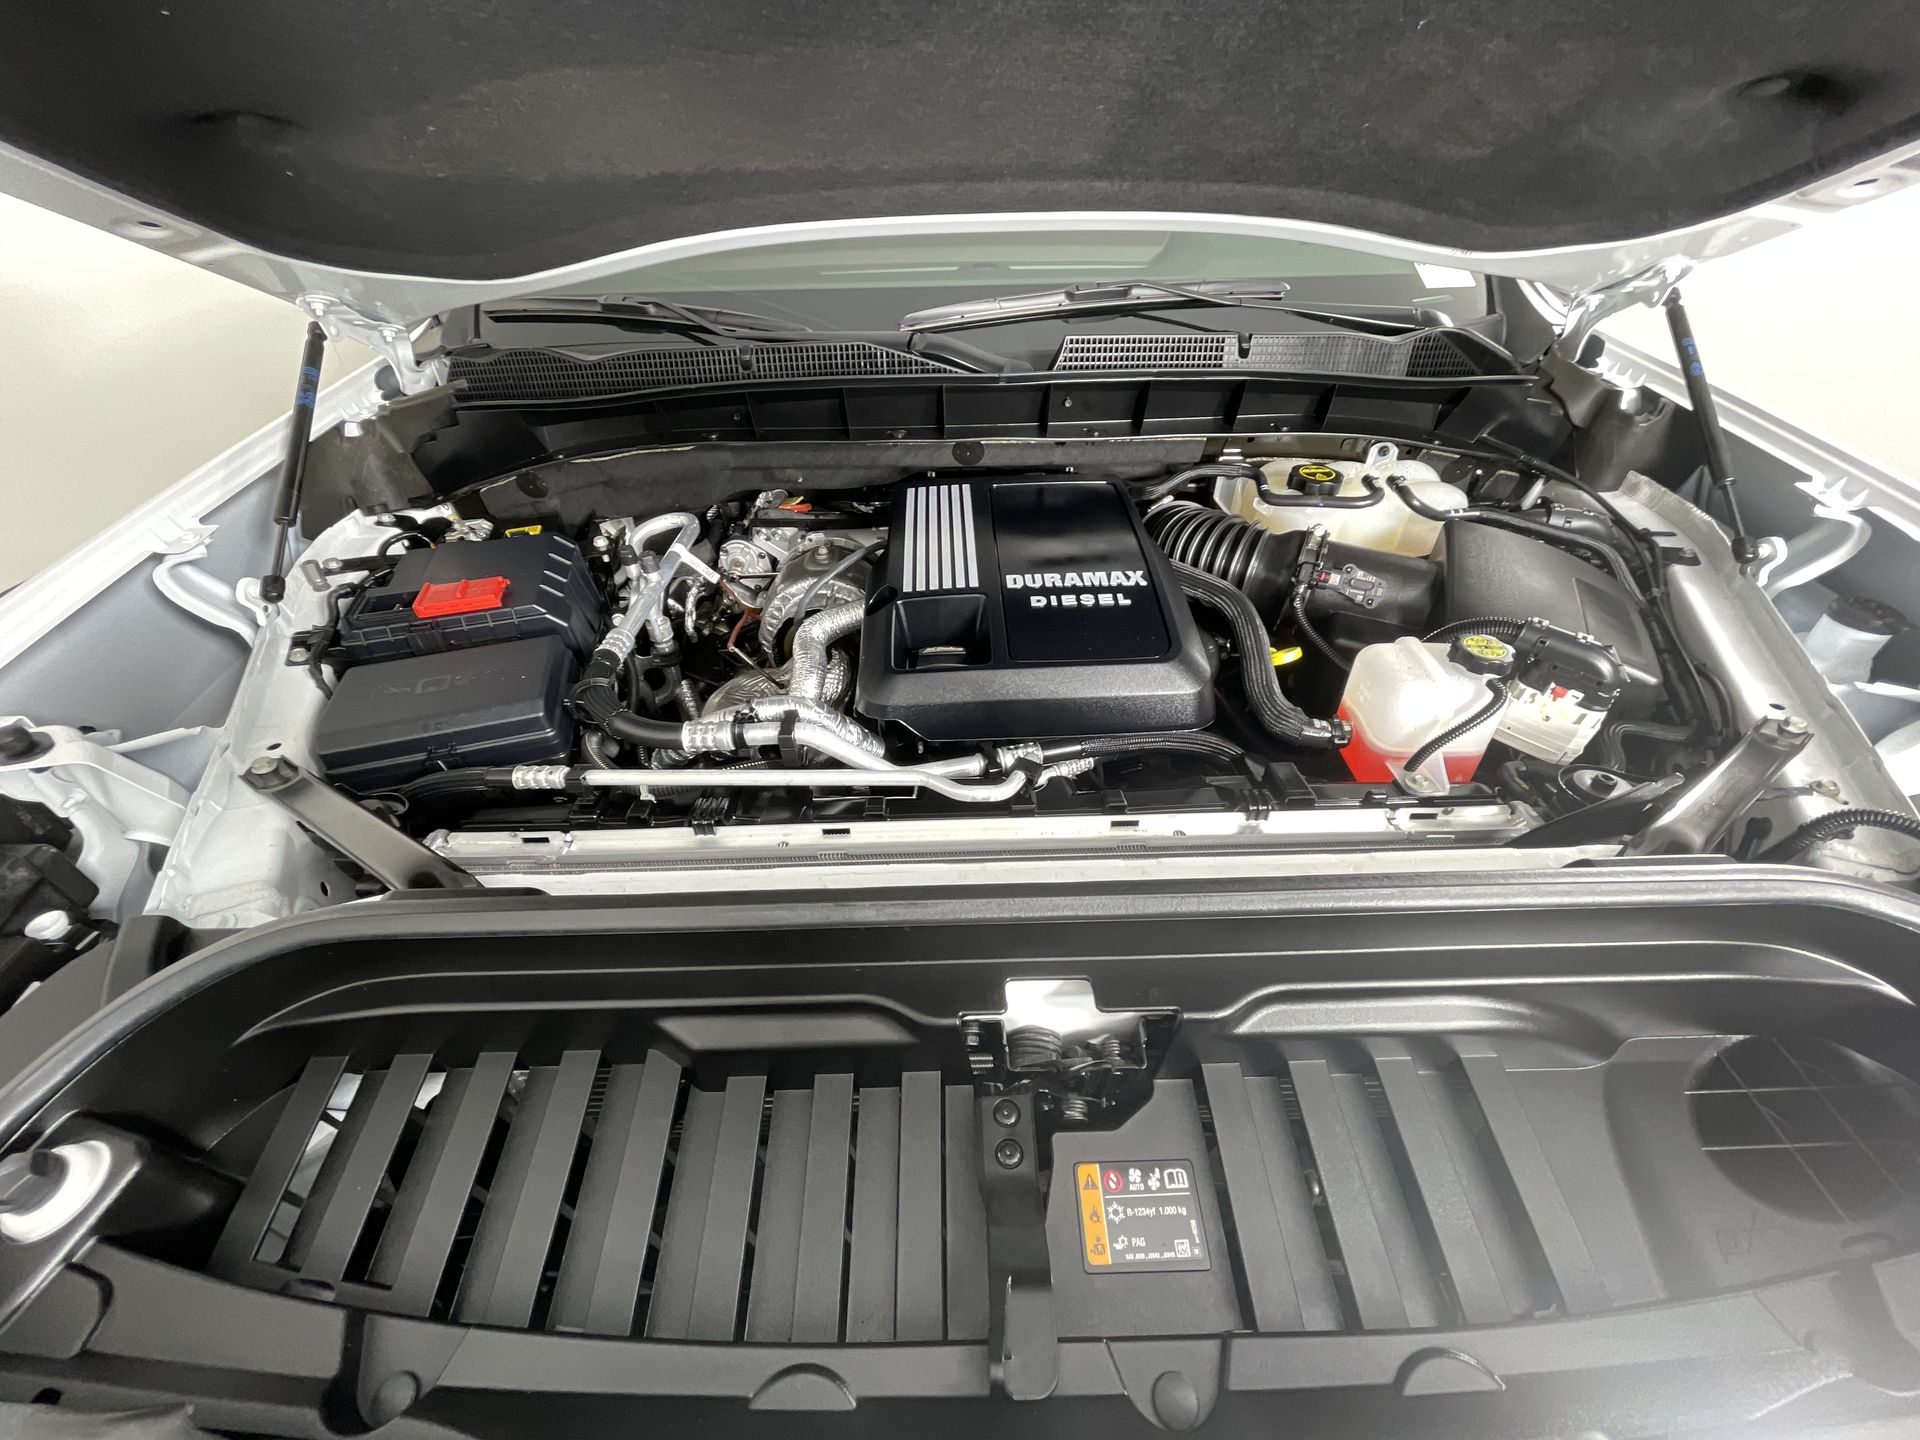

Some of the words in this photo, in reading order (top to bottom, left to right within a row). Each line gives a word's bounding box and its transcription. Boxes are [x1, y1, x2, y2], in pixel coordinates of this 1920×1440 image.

[1005, 570, 1148, 589] DURAMAX
[1030, 593, 1132, 608] DIESEL
[1129, 1183, 1145, 1191] AUTO
[1126, 1207, 1156, 1217] R-1234yf
[1158, 1206, 1177, 1215] 1.000
[1177, 1205, 1187, 1216] kg
[1131, 1237, 1146, 1247] PAG
